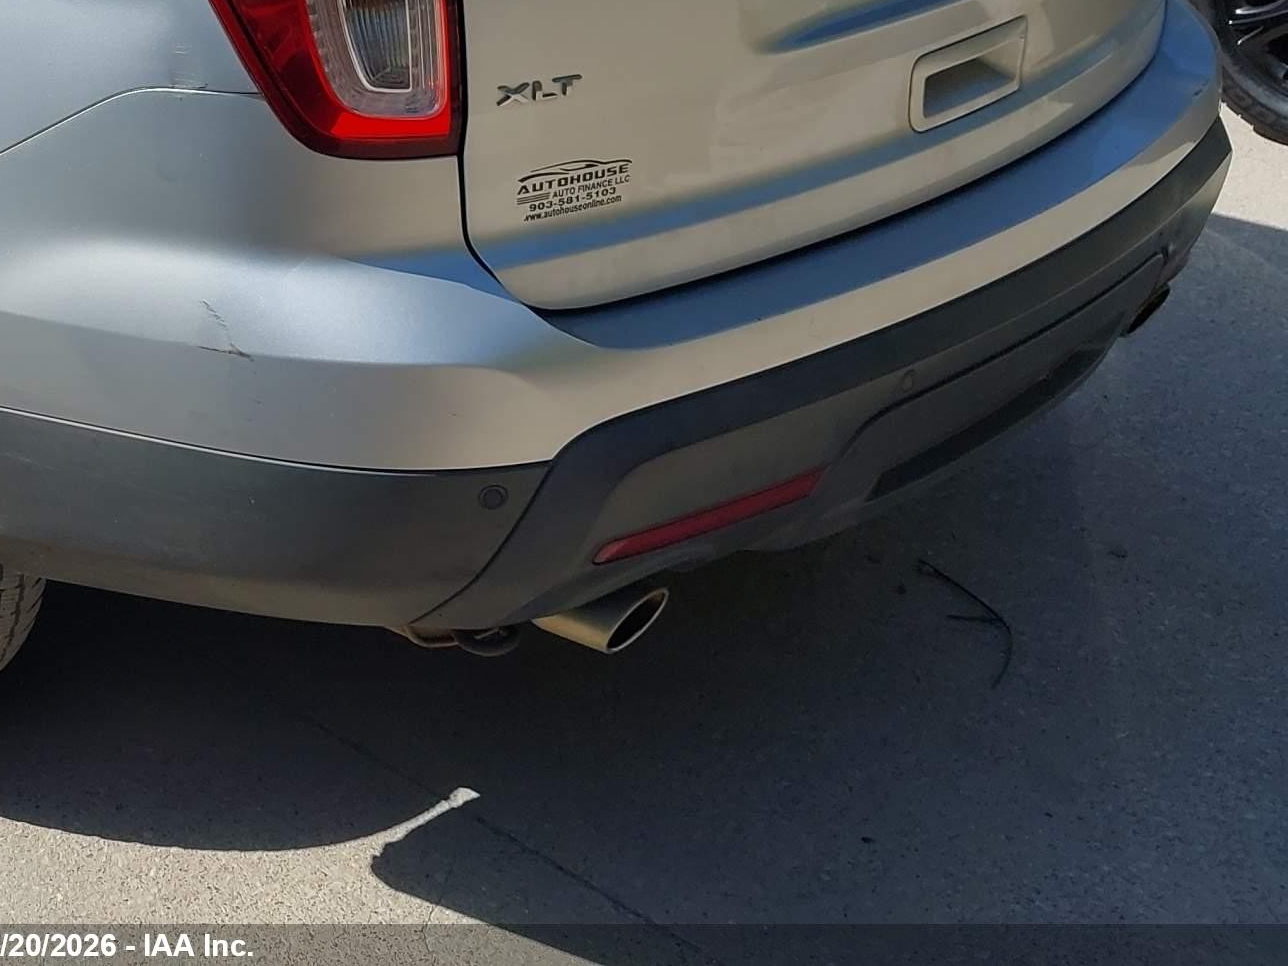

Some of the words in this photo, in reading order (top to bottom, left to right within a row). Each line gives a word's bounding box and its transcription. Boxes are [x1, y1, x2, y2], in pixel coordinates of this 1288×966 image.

[496, 73, 583, 107] XLT
[517, 163, 629, 195] AUTOHOUSE
[553, 187, 576, 199] AUTO
[578, 178, 613, 192] FINANCE
[615, 174, 631, 185] LLC
[529, 186, 616, 212] 903-581-5103
